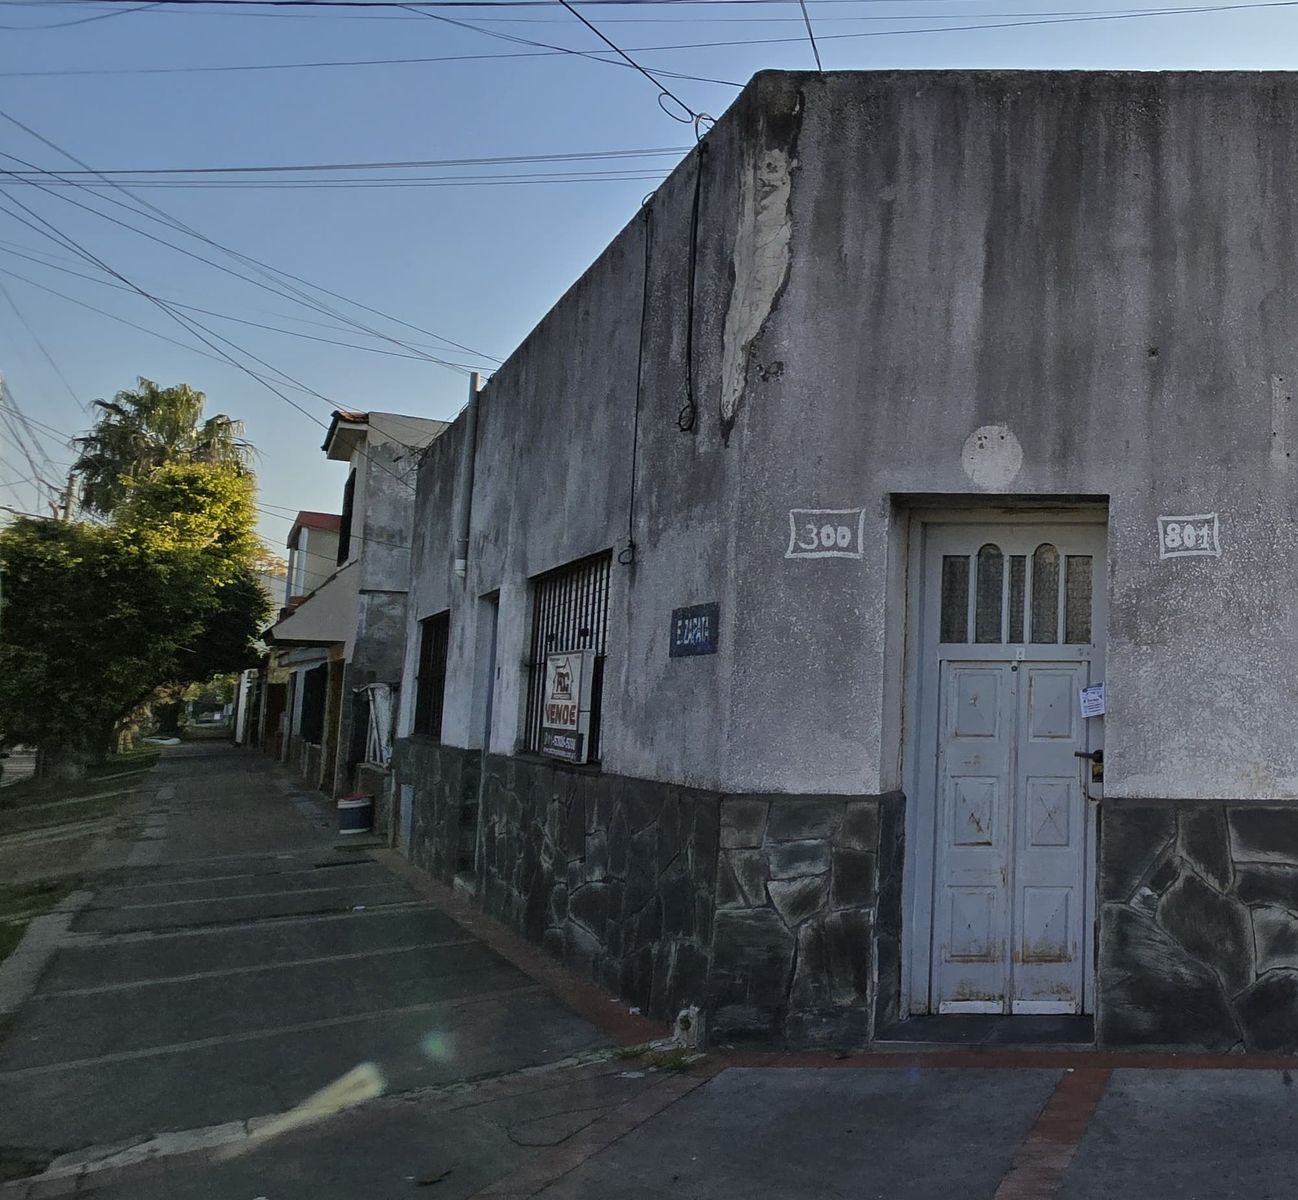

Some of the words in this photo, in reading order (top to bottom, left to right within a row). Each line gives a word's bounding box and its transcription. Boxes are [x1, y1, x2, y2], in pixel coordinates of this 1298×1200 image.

[797, 524, 851, 549] 300
[1164, 523, 1210, 548] 801
[545, 703, 577, 725] VENDE
